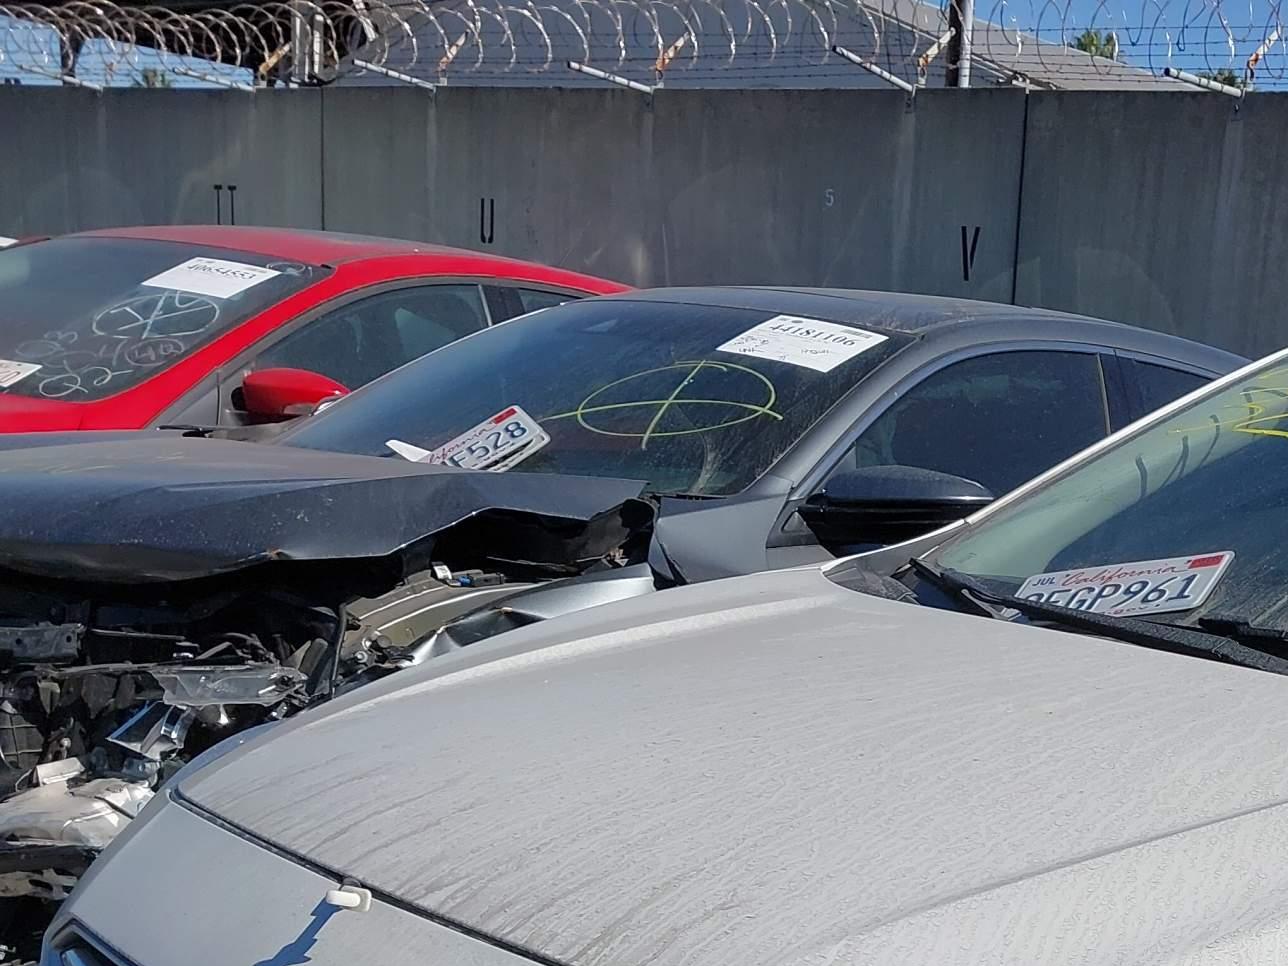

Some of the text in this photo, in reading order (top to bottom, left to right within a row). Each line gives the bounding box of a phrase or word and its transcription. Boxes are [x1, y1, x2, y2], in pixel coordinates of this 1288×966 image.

[769, 323, 856, 347] 44181106
[1032, 563, 1184, 587] JUL California
